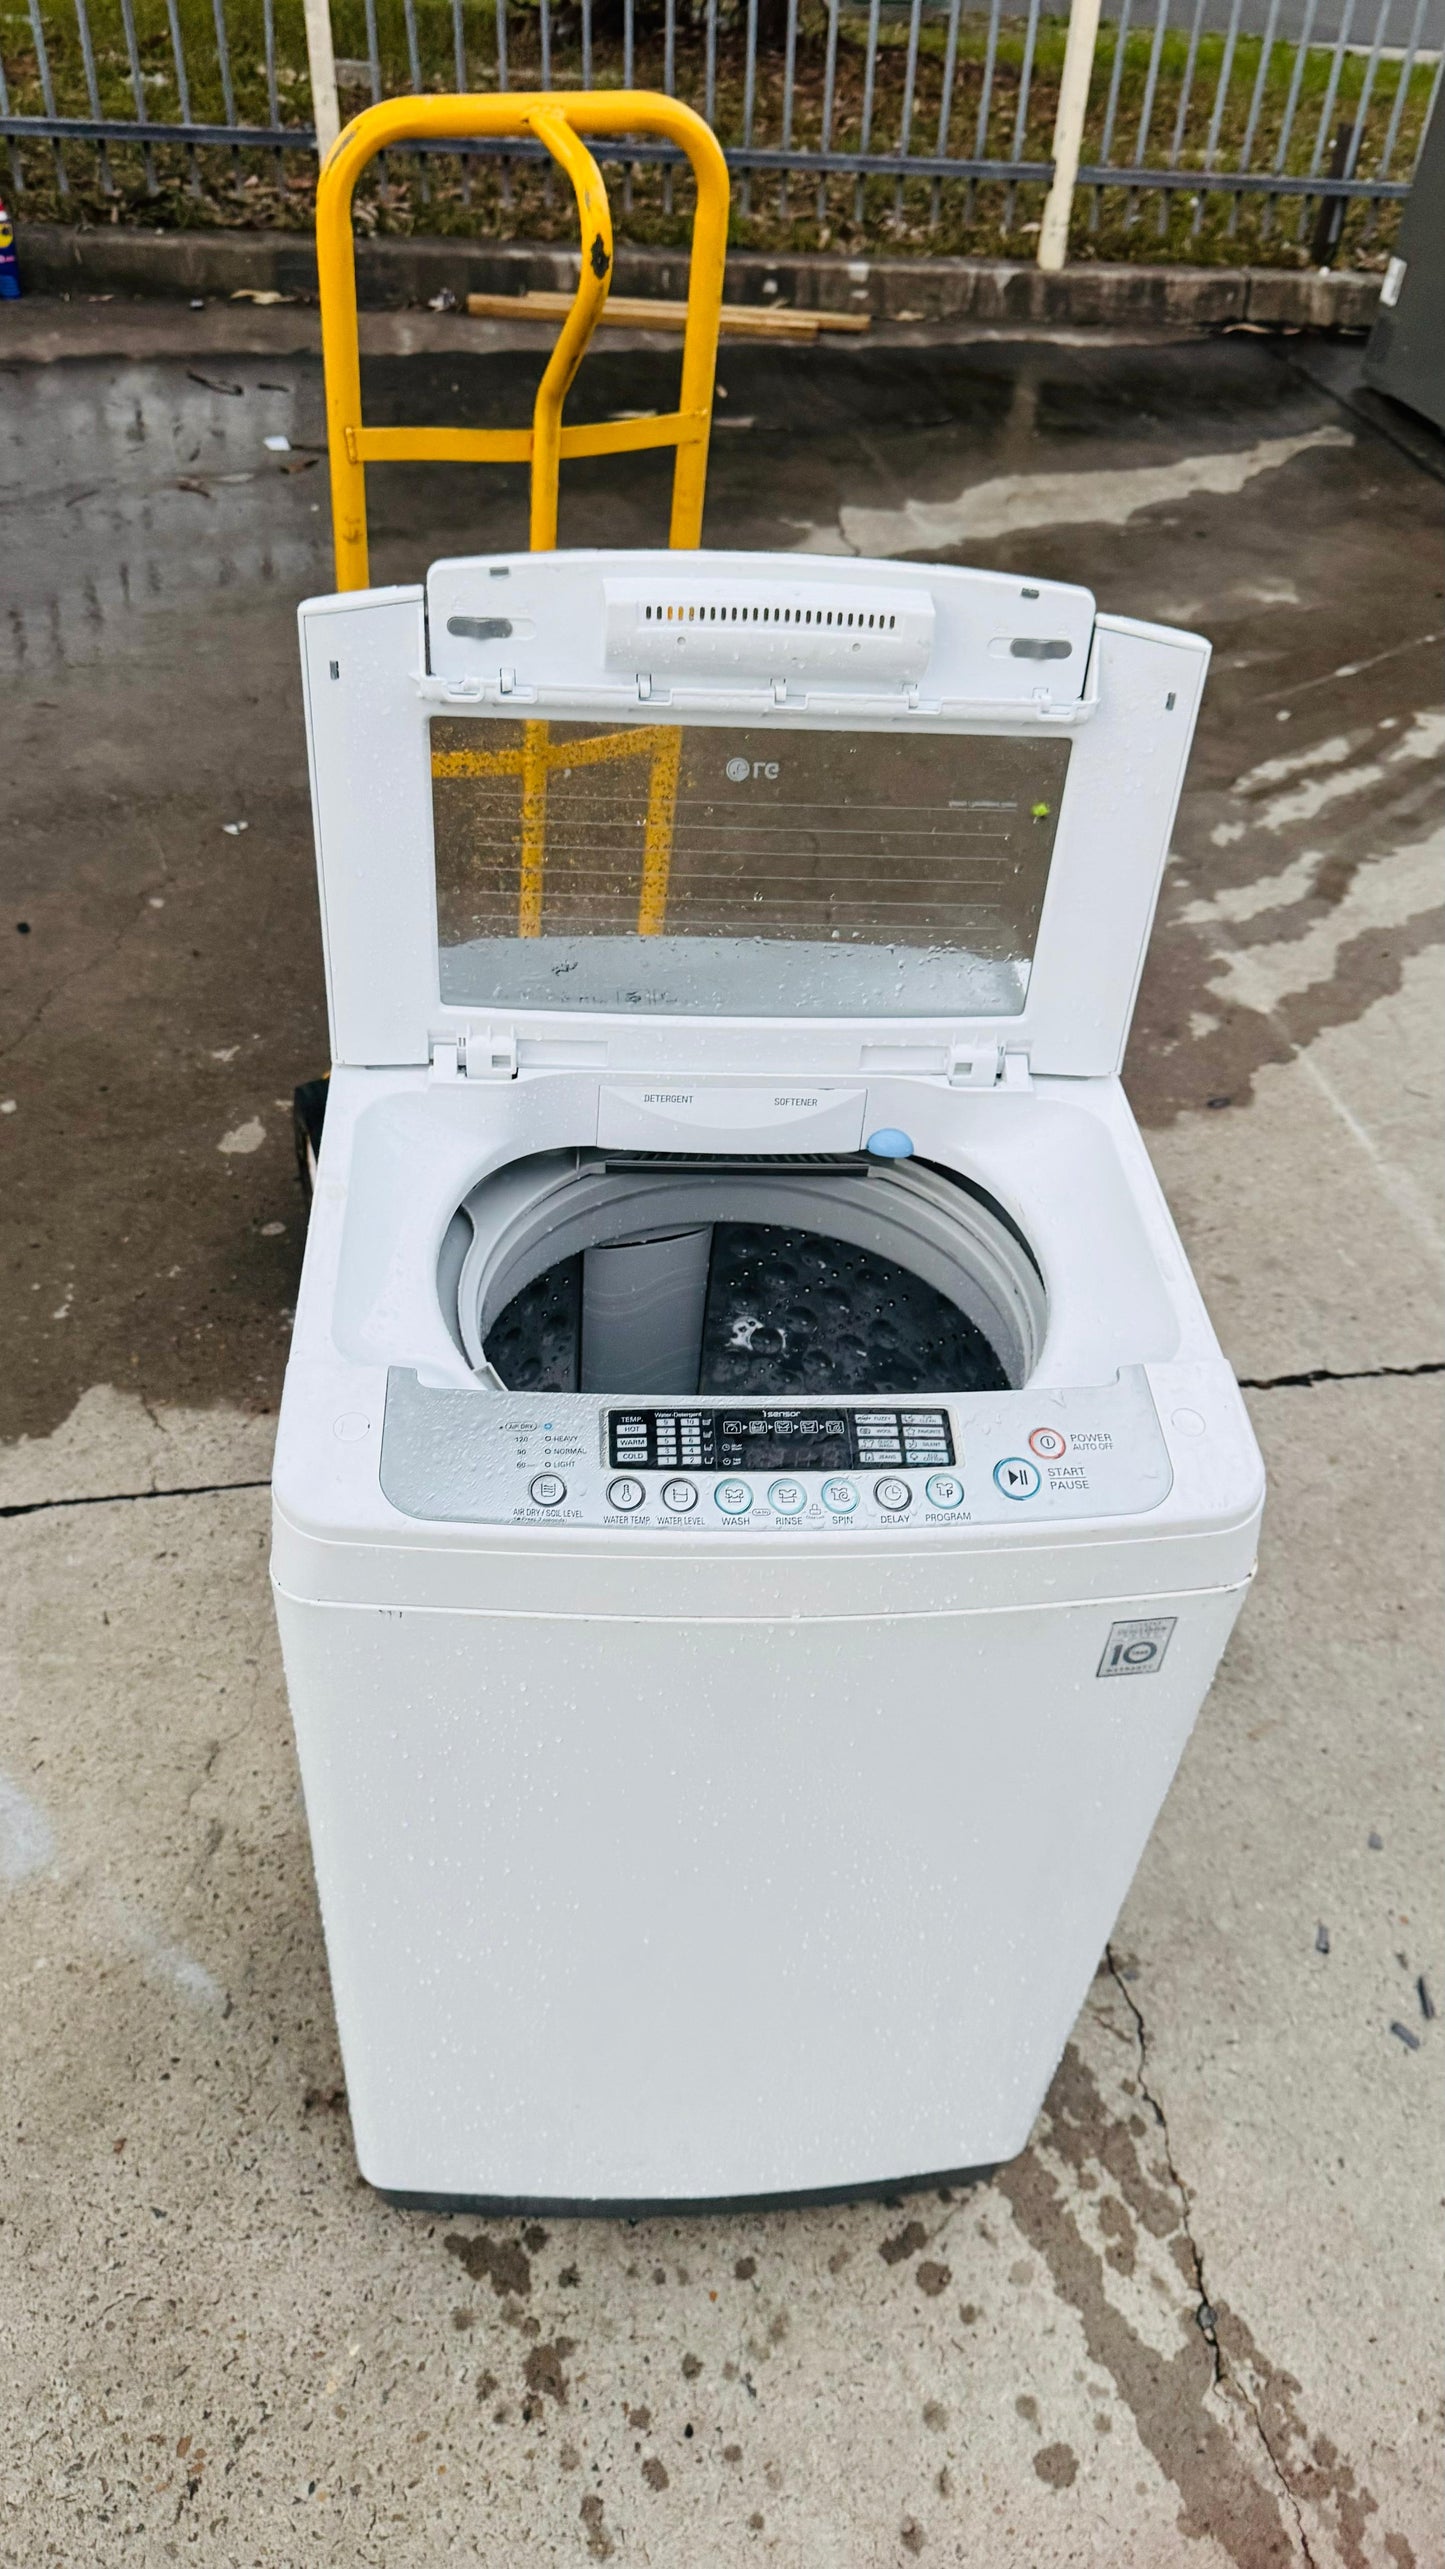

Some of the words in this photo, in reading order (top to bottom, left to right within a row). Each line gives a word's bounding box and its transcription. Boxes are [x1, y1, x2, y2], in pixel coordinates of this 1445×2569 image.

[644, 1094, 694, 1104] DETERGENT
[774, 1097, 818, 1107] SOFTENER
[624, 1425, 640, 1433] HOT
[1070, 1433, 1112, 1442] POWER
[1073, 1442, 1097, 1451] AUTO
[1098, 1442, 1114, 1450] OFF
[1048, 1467, 1085, 1476] START
[1050, 1480, 1090, 1490] PAUSE
[513, 1508, 525, 1516] AIR
[526, 1508, 540, 1516] DRY
[563, 1510, 584, 1518] LEVEL
[925, 1513, 972, 1522] PROGRAM
[604, 1515, 629, 1525] WATER
[656, 1516, 682, 1525] WATER
[684, 1516, 706, 1526] LEVEL
[721, 1517, 751, 1526] WASH
[775, 1516, 803, 1526] RINSE
[832, 1515, 854, 1525] SPIN
[880, 1515, 911, 1525] DELAY
[1110, 1641, 1158, 1667] 10
